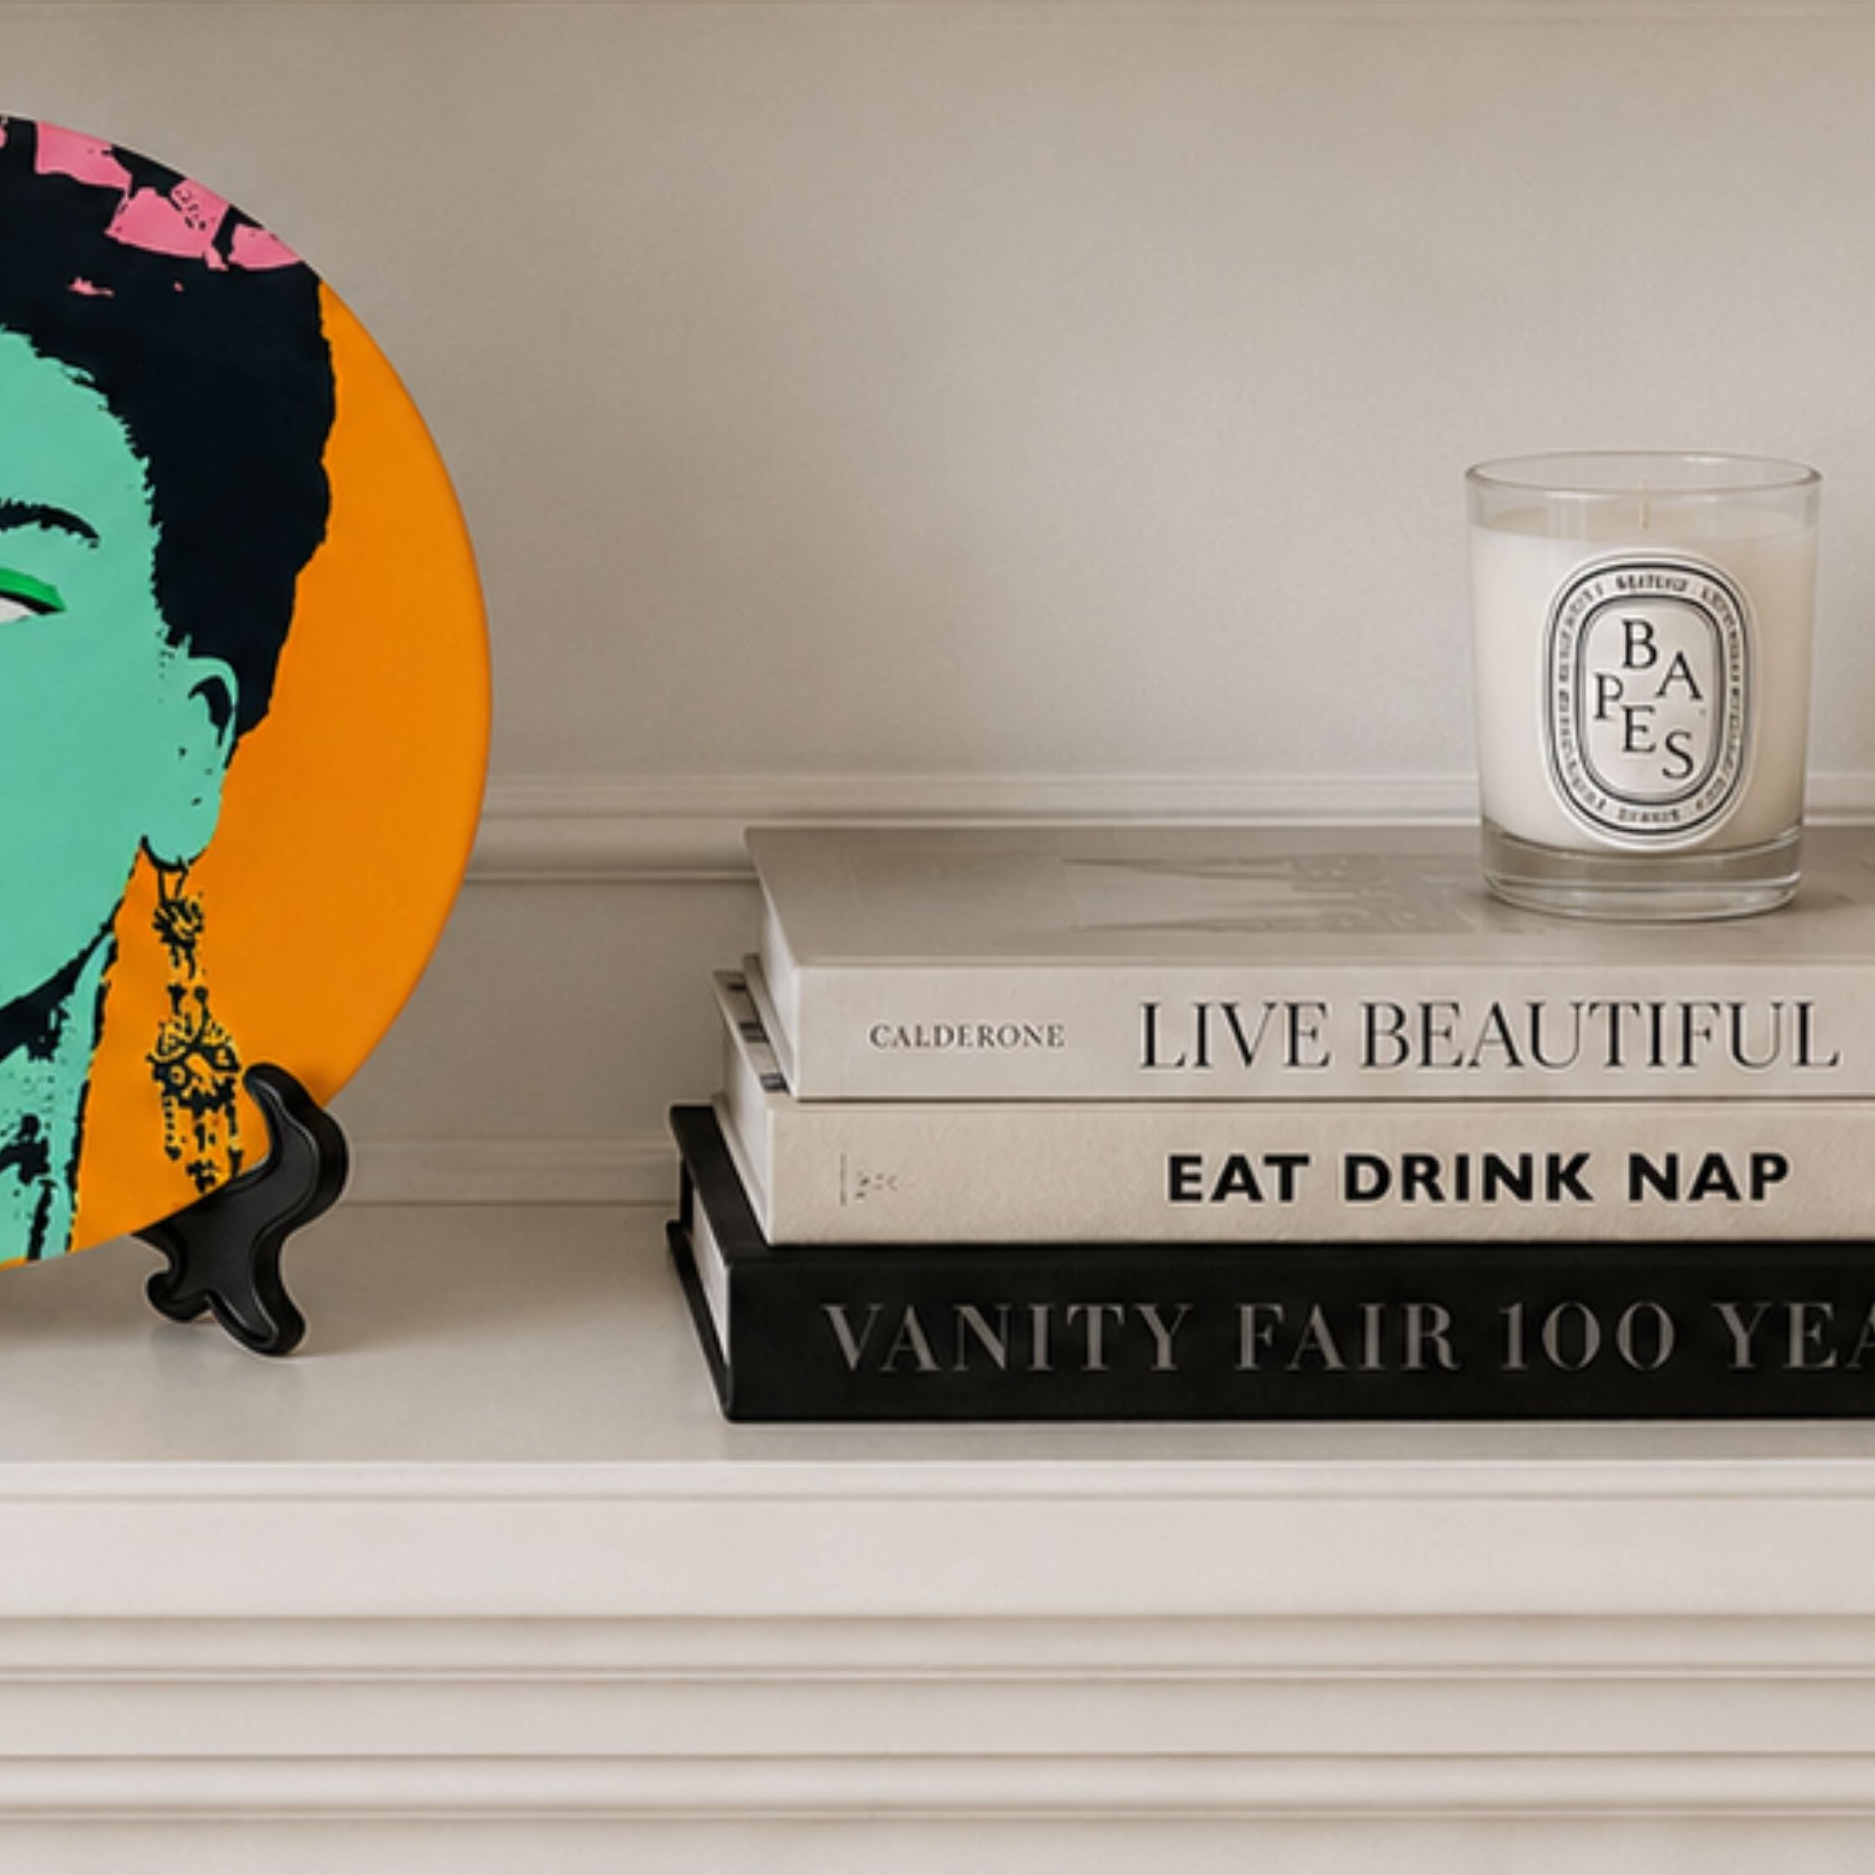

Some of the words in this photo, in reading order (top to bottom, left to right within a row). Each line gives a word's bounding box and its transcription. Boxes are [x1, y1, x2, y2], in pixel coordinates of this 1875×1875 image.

[868, 1022, 1067, 1049] CALDERONE
[1139, 1000, 1331, 1072] LIVE
[1360, 1000, 1841, 1072] BEAUTIFUL
[1166, 1151, 1312, 1204] EAT
[1342, 1151, 1596, 1204] DRINK
[1627, 1151, 1791, 1204] NAP
[820, 1301, 1193, 1374] VANITY
[1233, 1301, 1462, 1372] FAIR
[1497, 1300, 1676, 1372] 100
